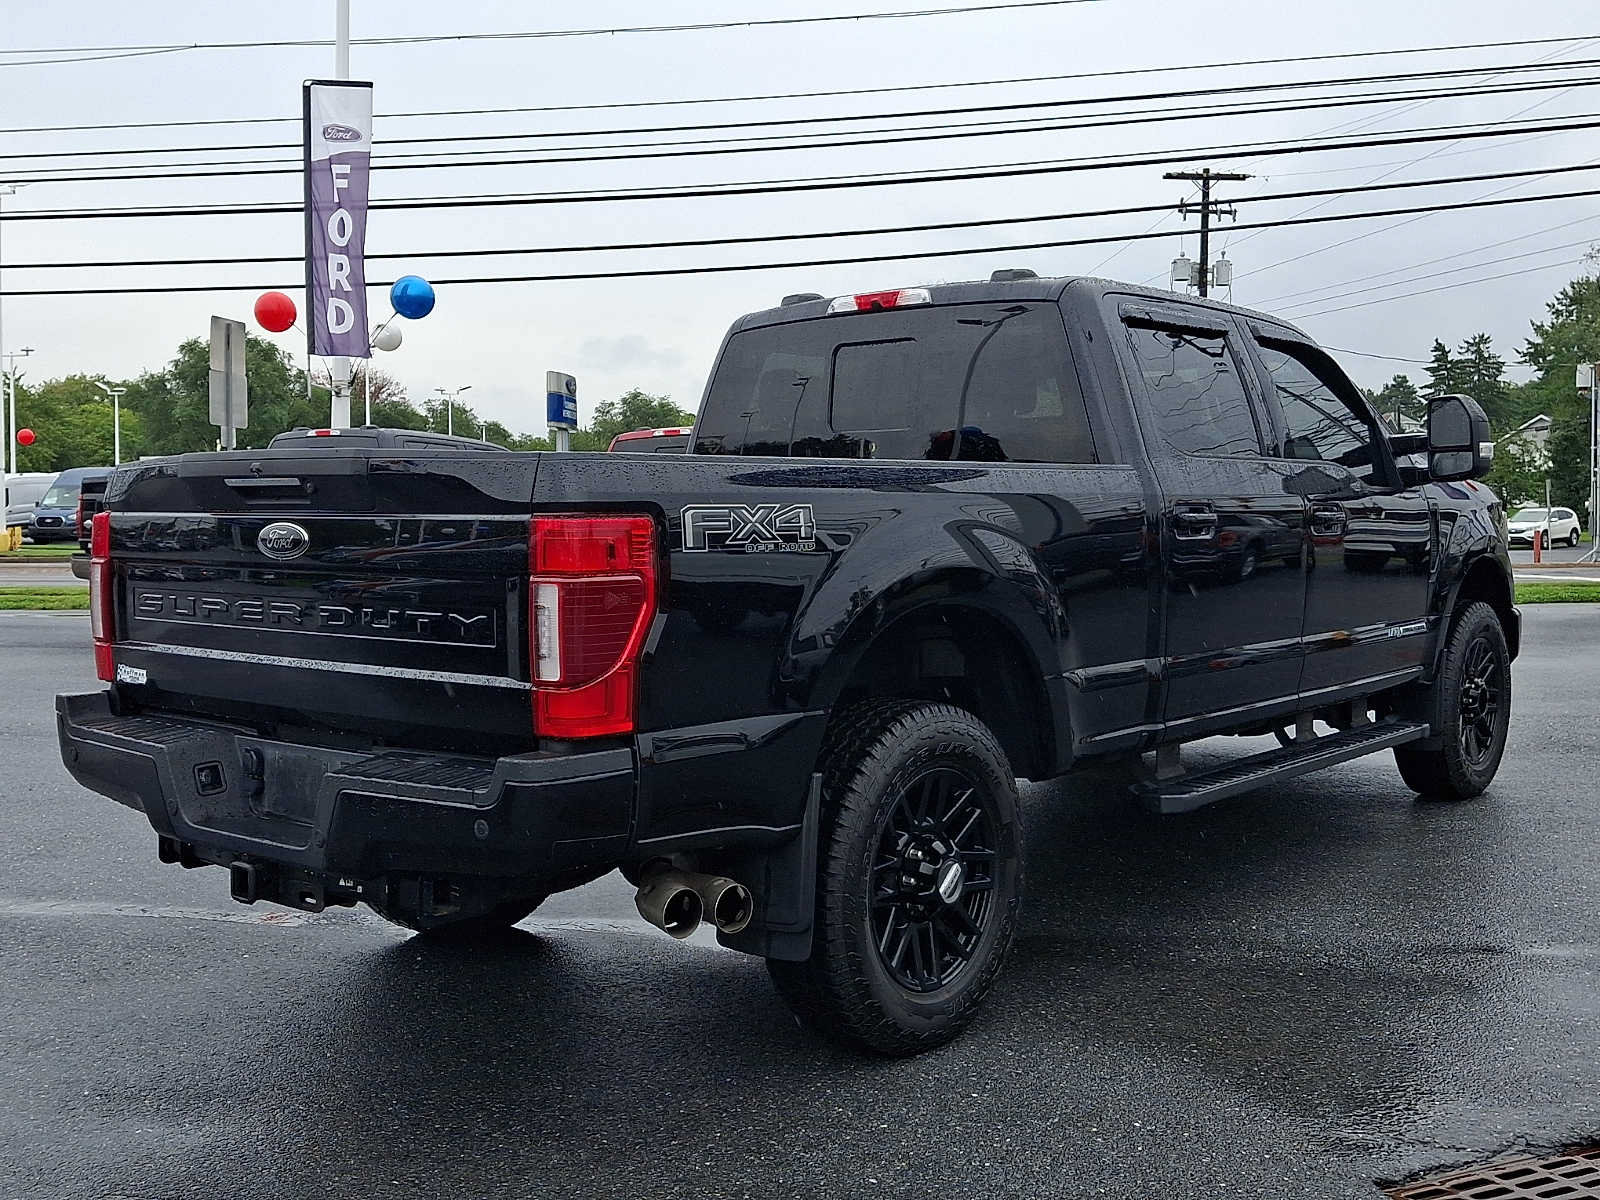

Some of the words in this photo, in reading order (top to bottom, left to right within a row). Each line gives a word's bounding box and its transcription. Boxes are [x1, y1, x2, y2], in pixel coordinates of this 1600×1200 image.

[325, 126, 352, 138] Ford
[327, 163, 355, 335] FORD
[266, 529, 294, 549] Ford
[680, 504, 816, 553] FX4
[745, 543, 774, 553] OFF
[778, 541, 816, 553] ROAD
[136, 593, 301, 626] SUPER
[319, 604, 489, 638] DUTY
